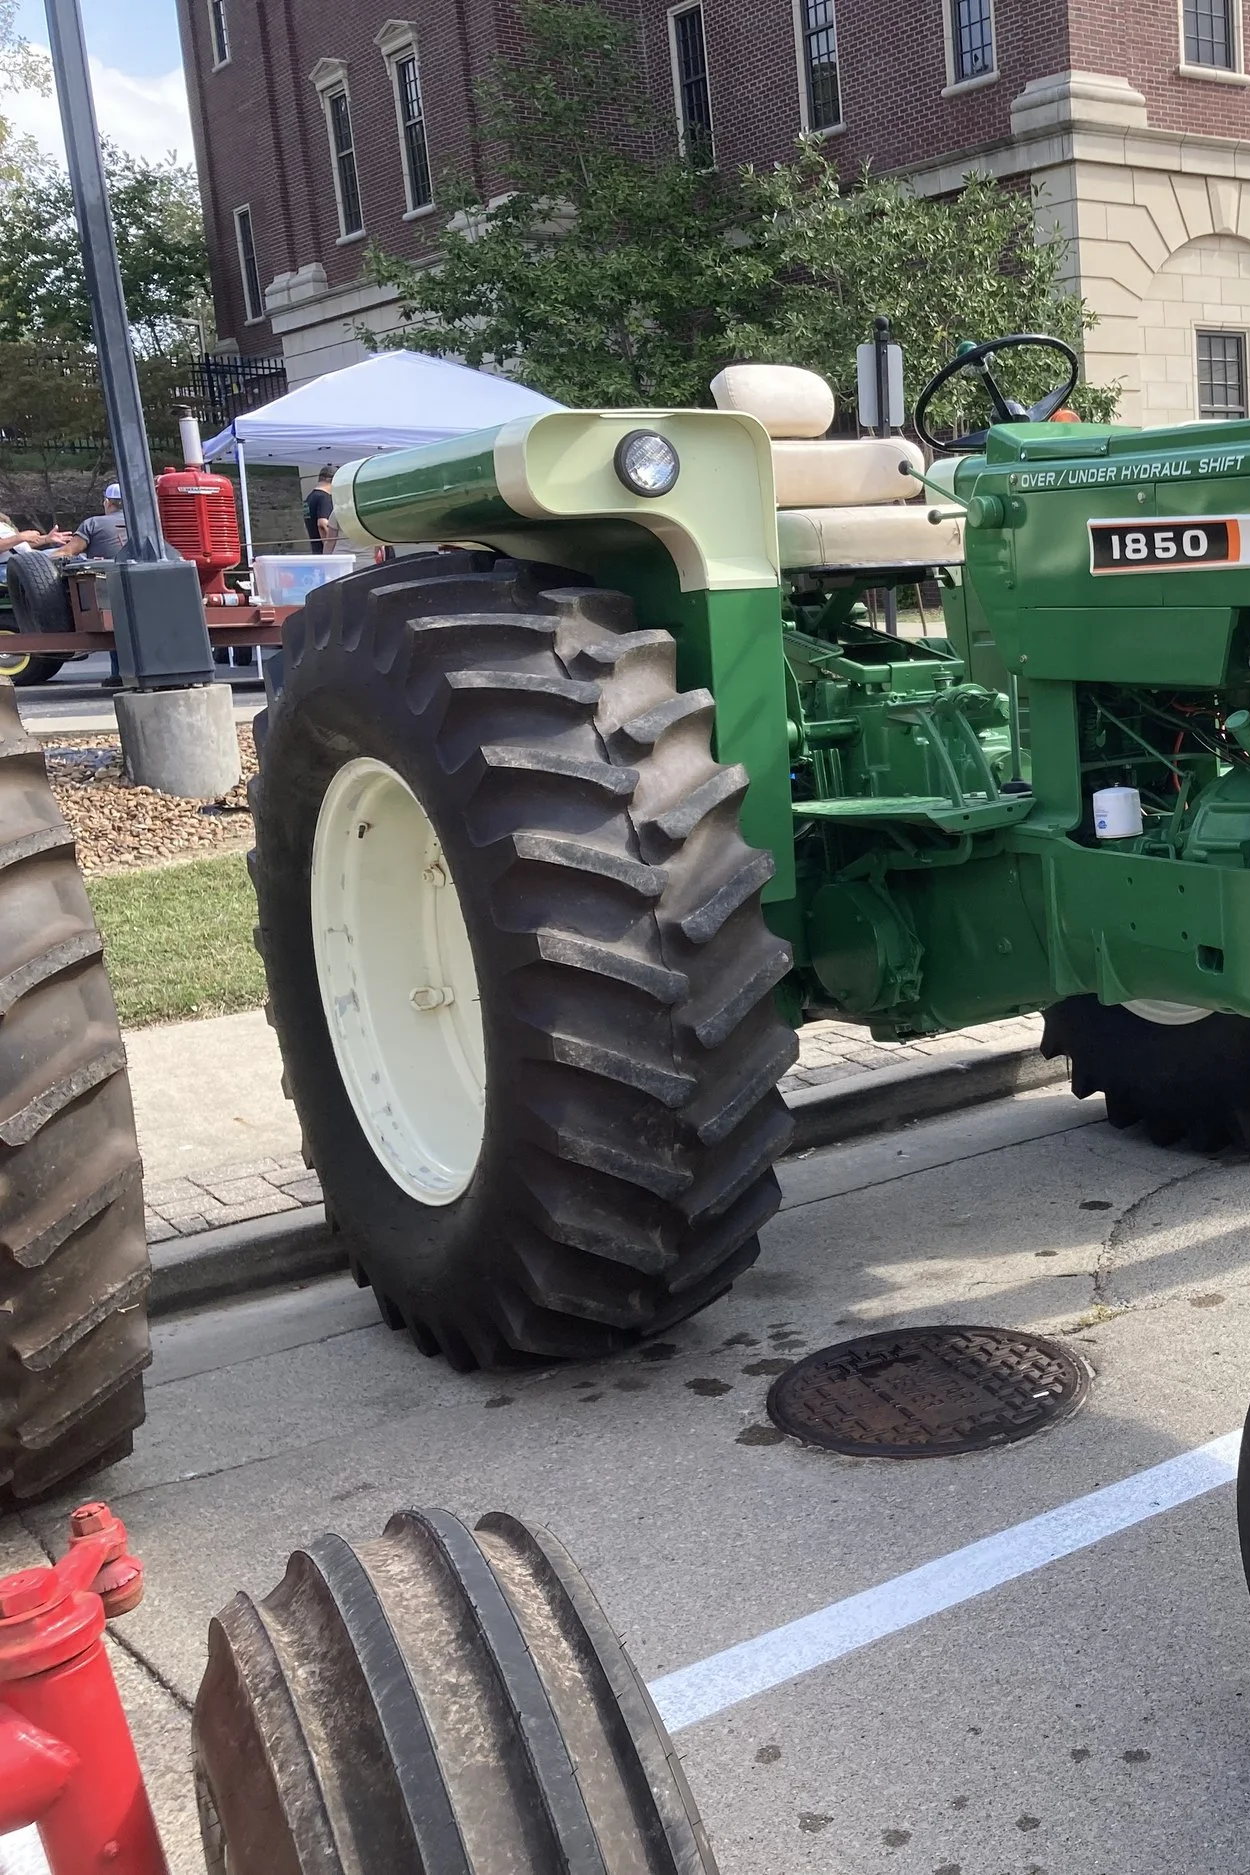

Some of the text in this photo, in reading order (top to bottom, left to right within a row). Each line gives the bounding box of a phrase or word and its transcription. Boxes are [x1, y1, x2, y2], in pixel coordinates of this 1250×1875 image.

[1120, 460, 1191, 480] HYDRAUL
[1198, 455, 1245, 473] SHIFT
[1111, 529, 1208, 560] 1850
